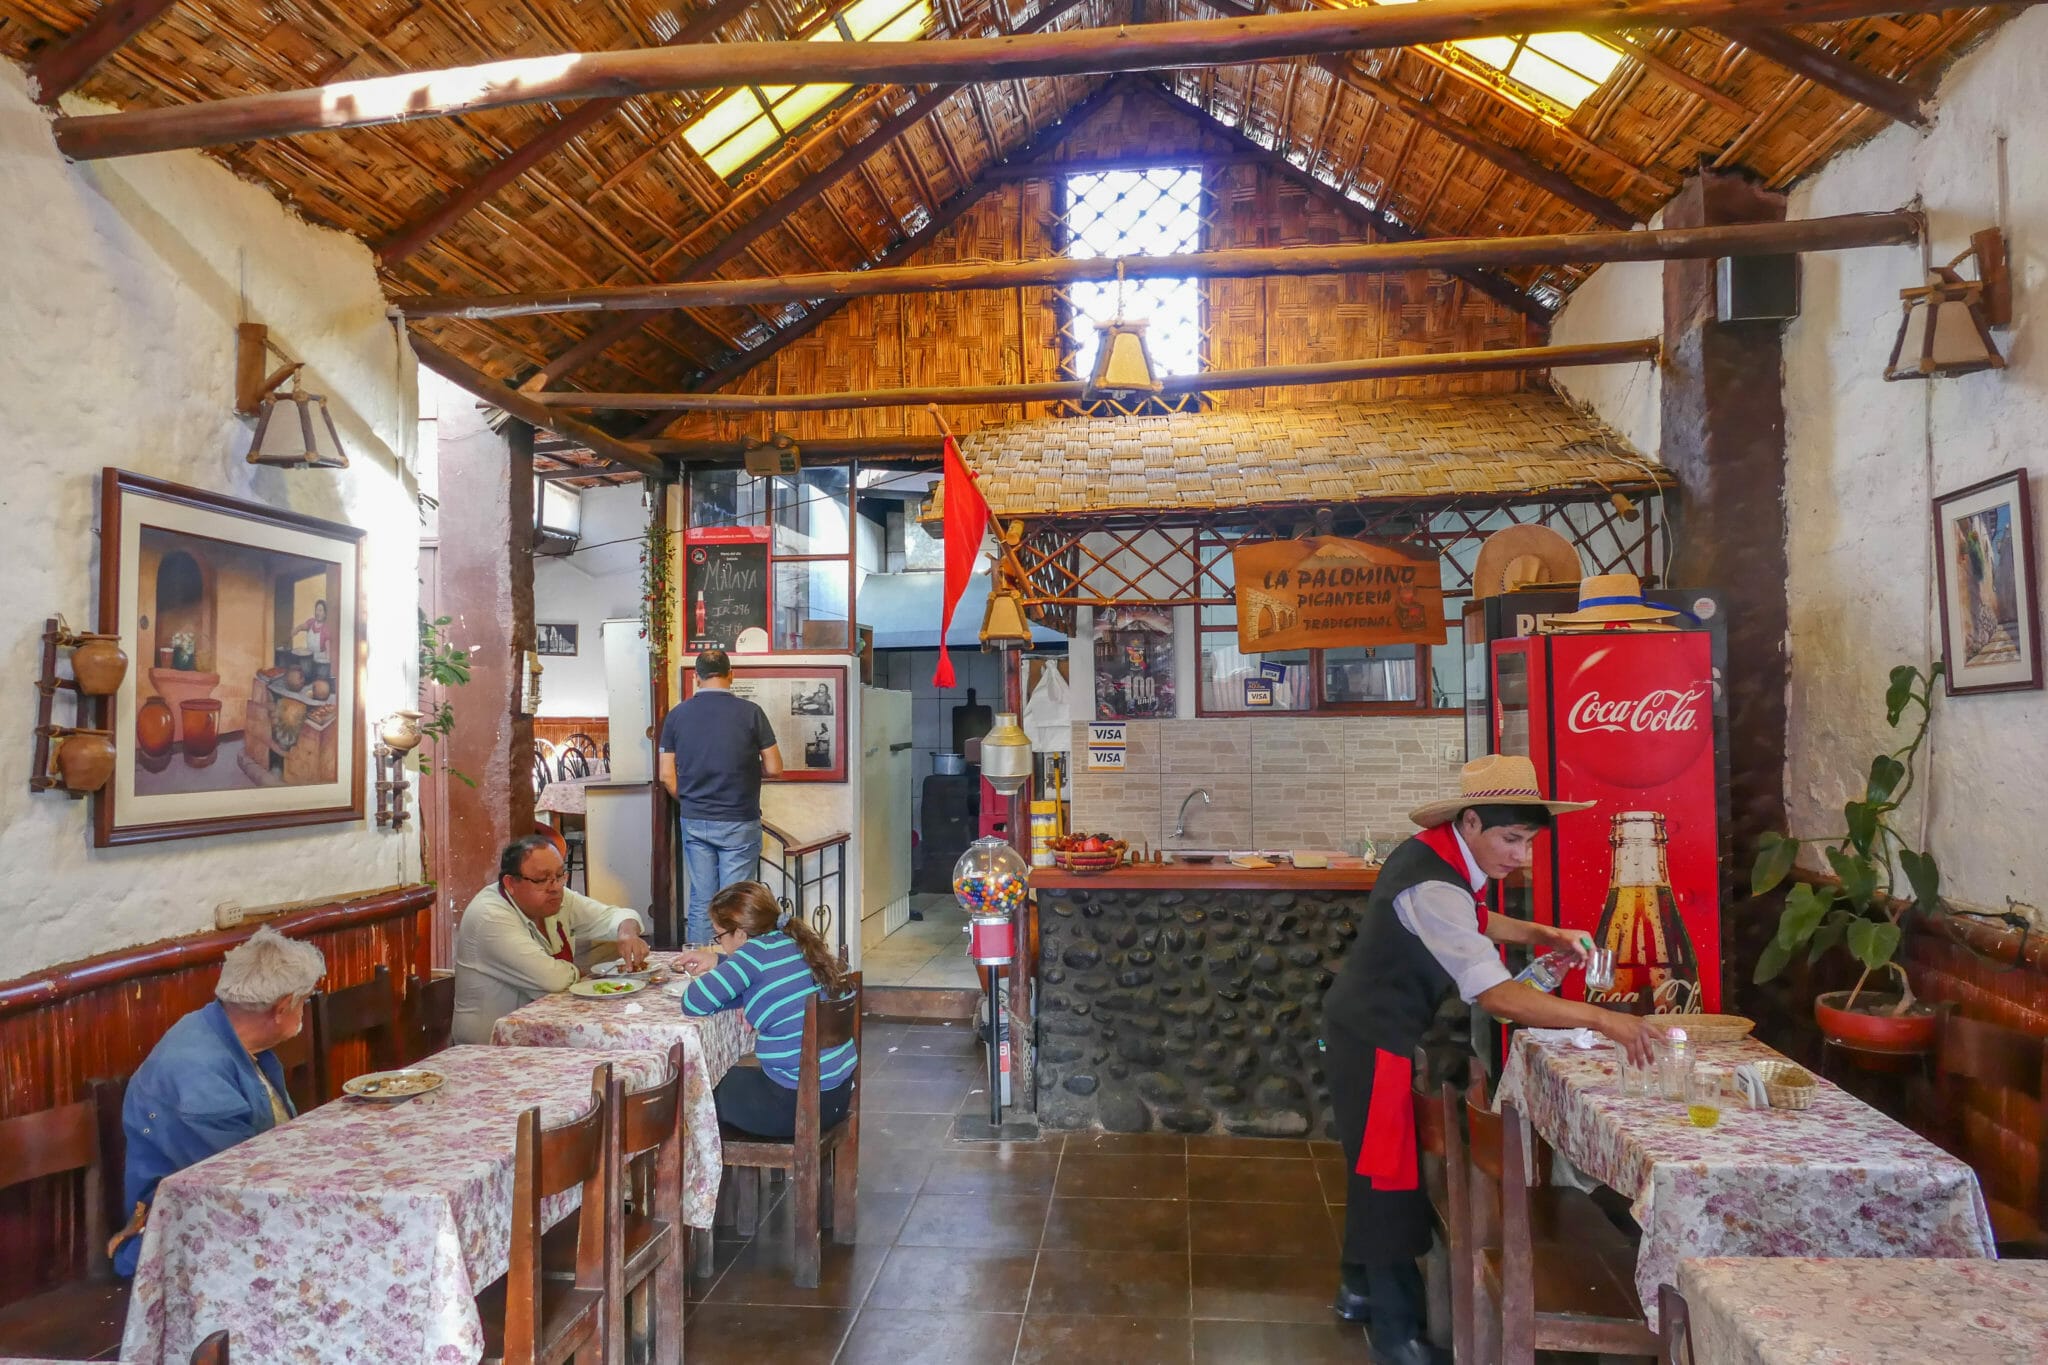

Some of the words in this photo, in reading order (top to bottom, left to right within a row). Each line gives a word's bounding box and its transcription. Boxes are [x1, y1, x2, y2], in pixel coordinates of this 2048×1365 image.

[1297, 566, 1417, 590] PALOMINO
[1297, 591, 1392, 609] PICANTERIA
[1303, 616, 1393, 631] TRADICIONAL
[1251, 692, 1269, 700] VISA
[1568, 689, 1706, 733] Coca-Cola
[1094, 729, 1122, 740] VISA
[1094, 753, 1121, 763] VISA
